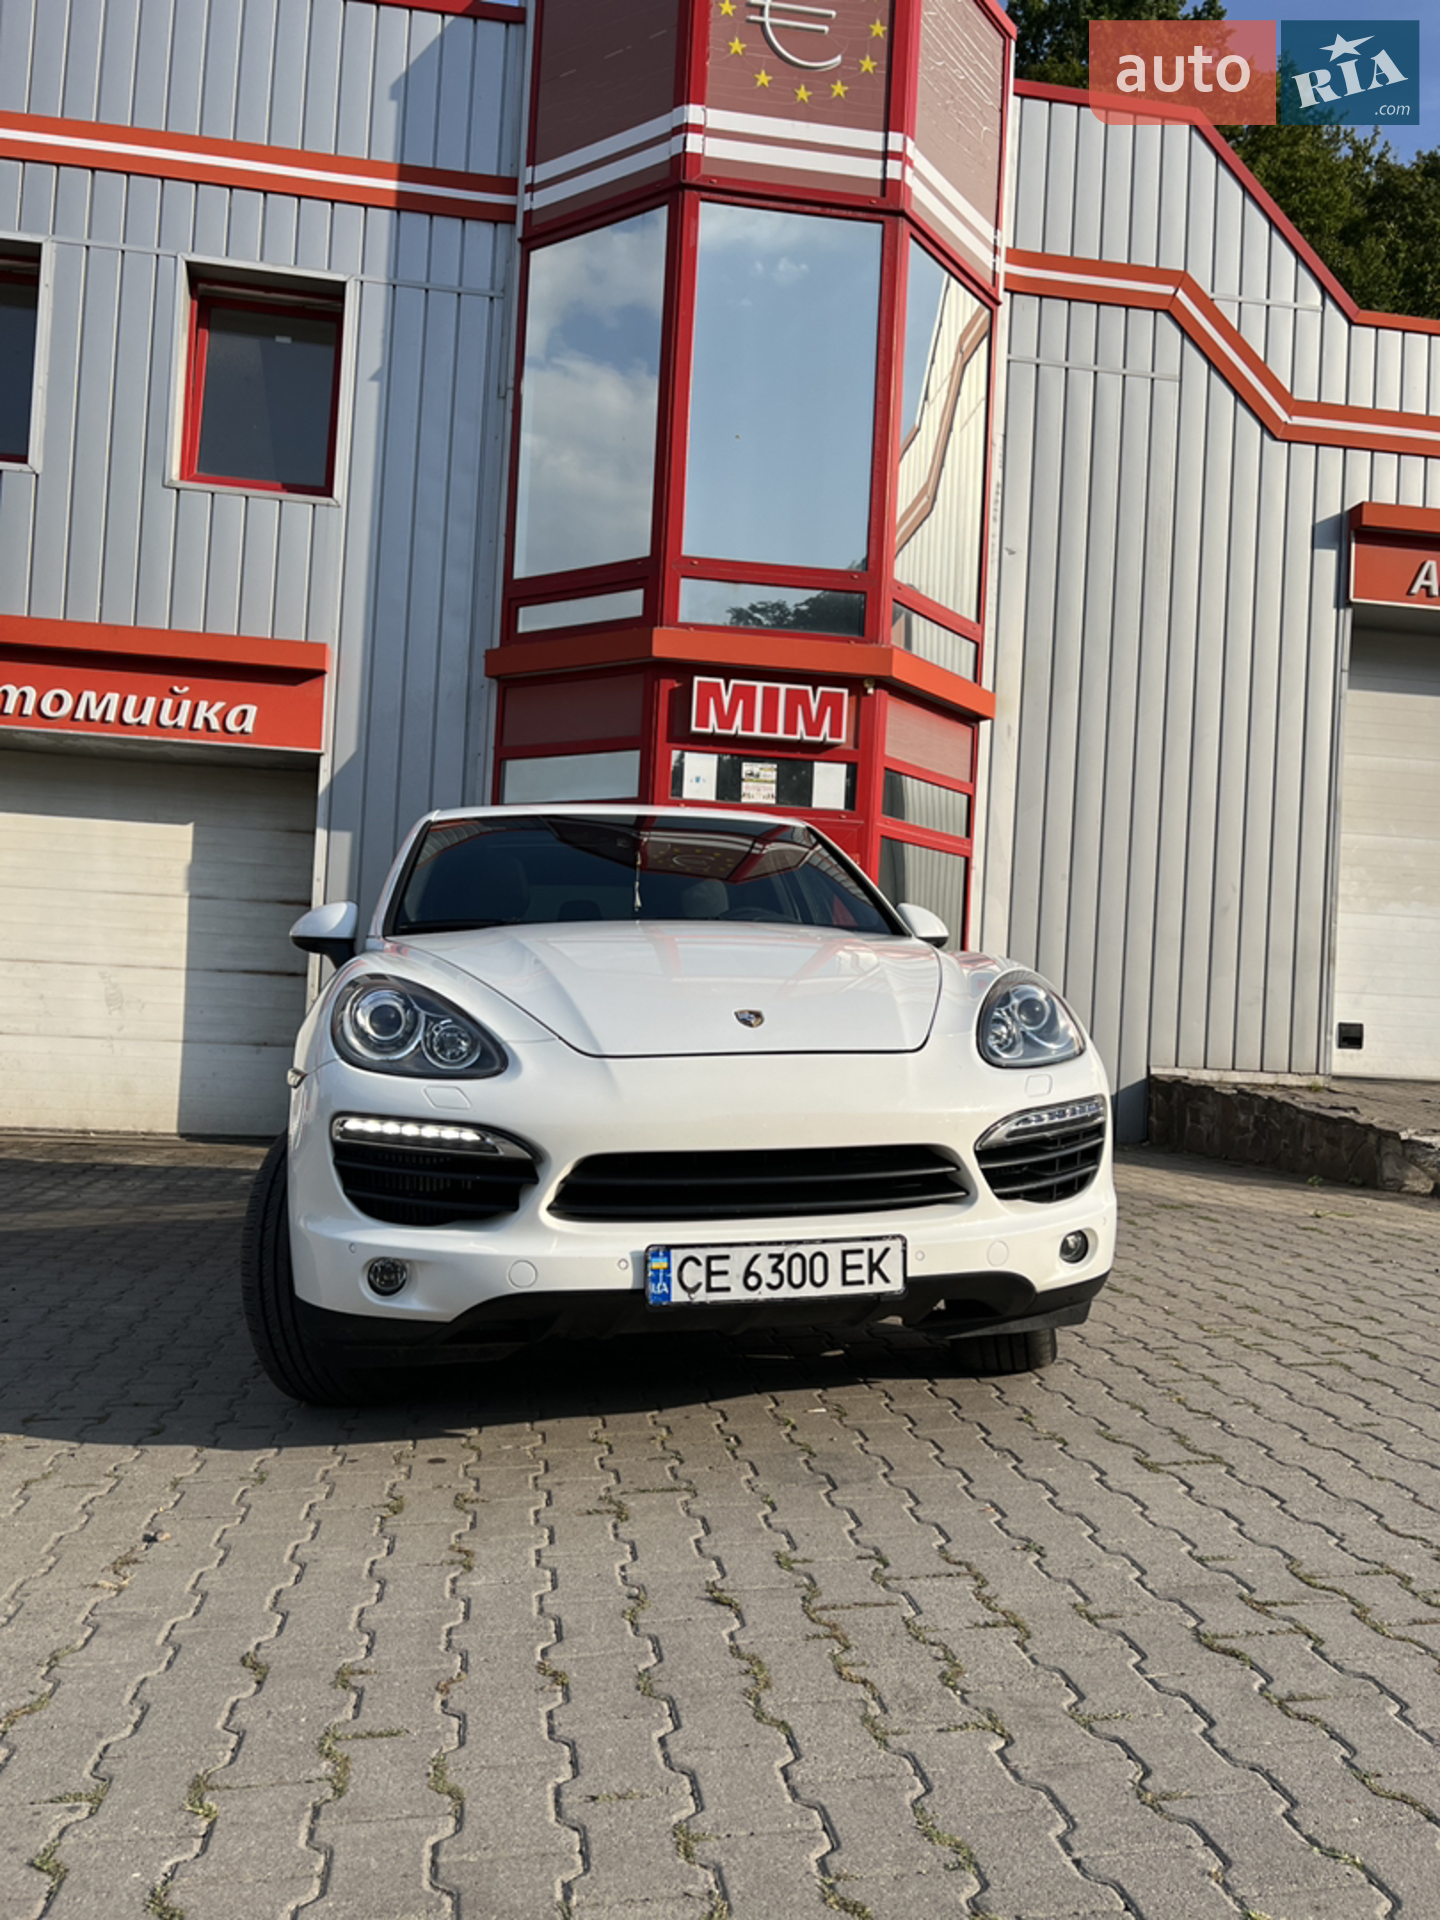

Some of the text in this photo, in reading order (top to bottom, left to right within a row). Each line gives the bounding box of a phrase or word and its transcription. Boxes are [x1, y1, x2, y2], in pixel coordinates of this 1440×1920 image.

[1408, 559, 1440, 598] А
[690, 676, 849, 744] MIM
[677, 1247, 891, 1296] CE 6300 EK
